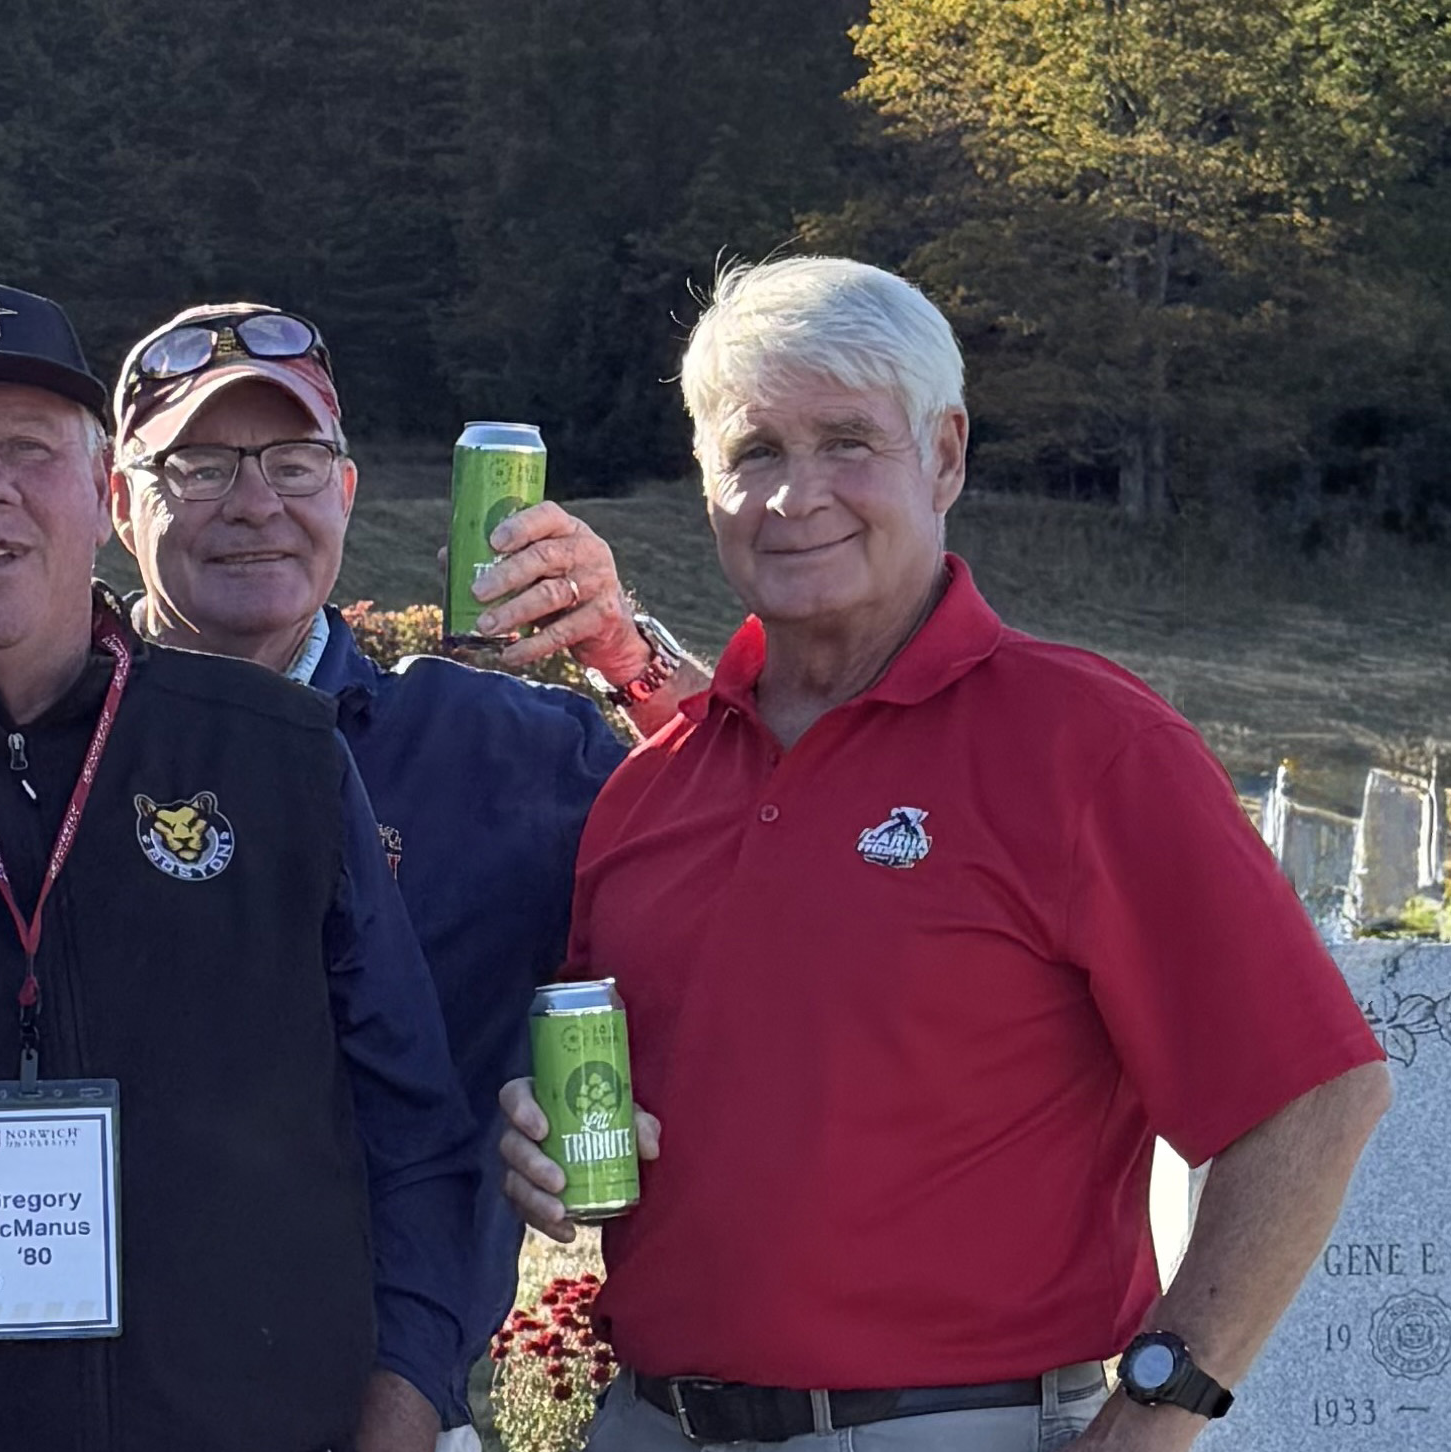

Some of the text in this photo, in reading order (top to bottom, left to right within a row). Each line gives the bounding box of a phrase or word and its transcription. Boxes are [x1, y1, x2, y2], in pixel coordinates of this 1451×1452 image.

[147, 843, 232, 878] BOSTON
[6, 1127, 79, 1140] NORWICH
[561, 1127, 633, 1163] TRIBUTE
[17, 1247, 53, 1266] '80
[1324, 1243, 1406, 1277] GENE
[1325, 1324, 1352, 1352] 19
[1313, 1399, 1377, 1427] 1933
